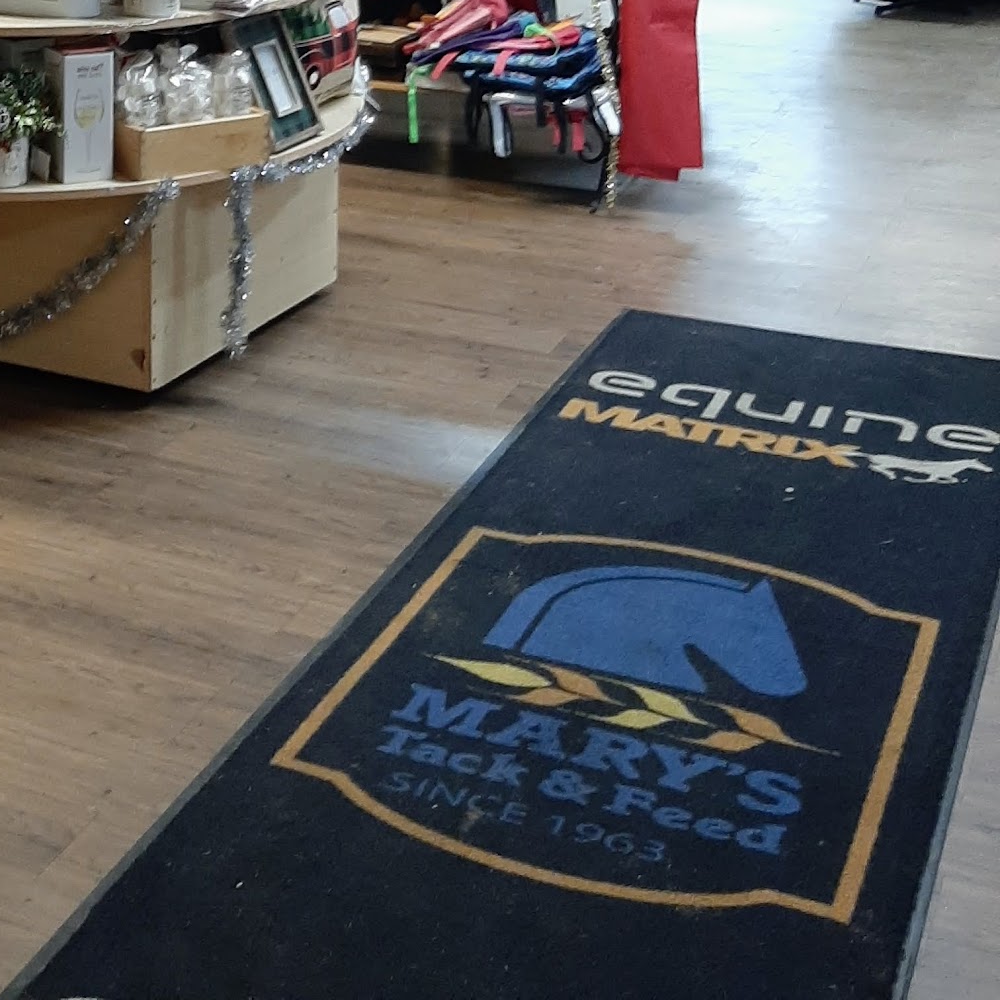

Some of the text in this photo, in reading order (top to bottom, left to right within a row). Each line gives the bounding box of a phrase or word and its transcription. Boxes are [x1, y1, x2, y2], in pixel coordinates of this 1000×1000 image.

[558, 397, 860, 468] MATRIX
[588, 370, 1000, 453] equine
[377, 724, 788, 855] Tack & Feed
[392, 682, 801, 816] MARY'S
[379, 771, 668, 862] SINCE 1963
